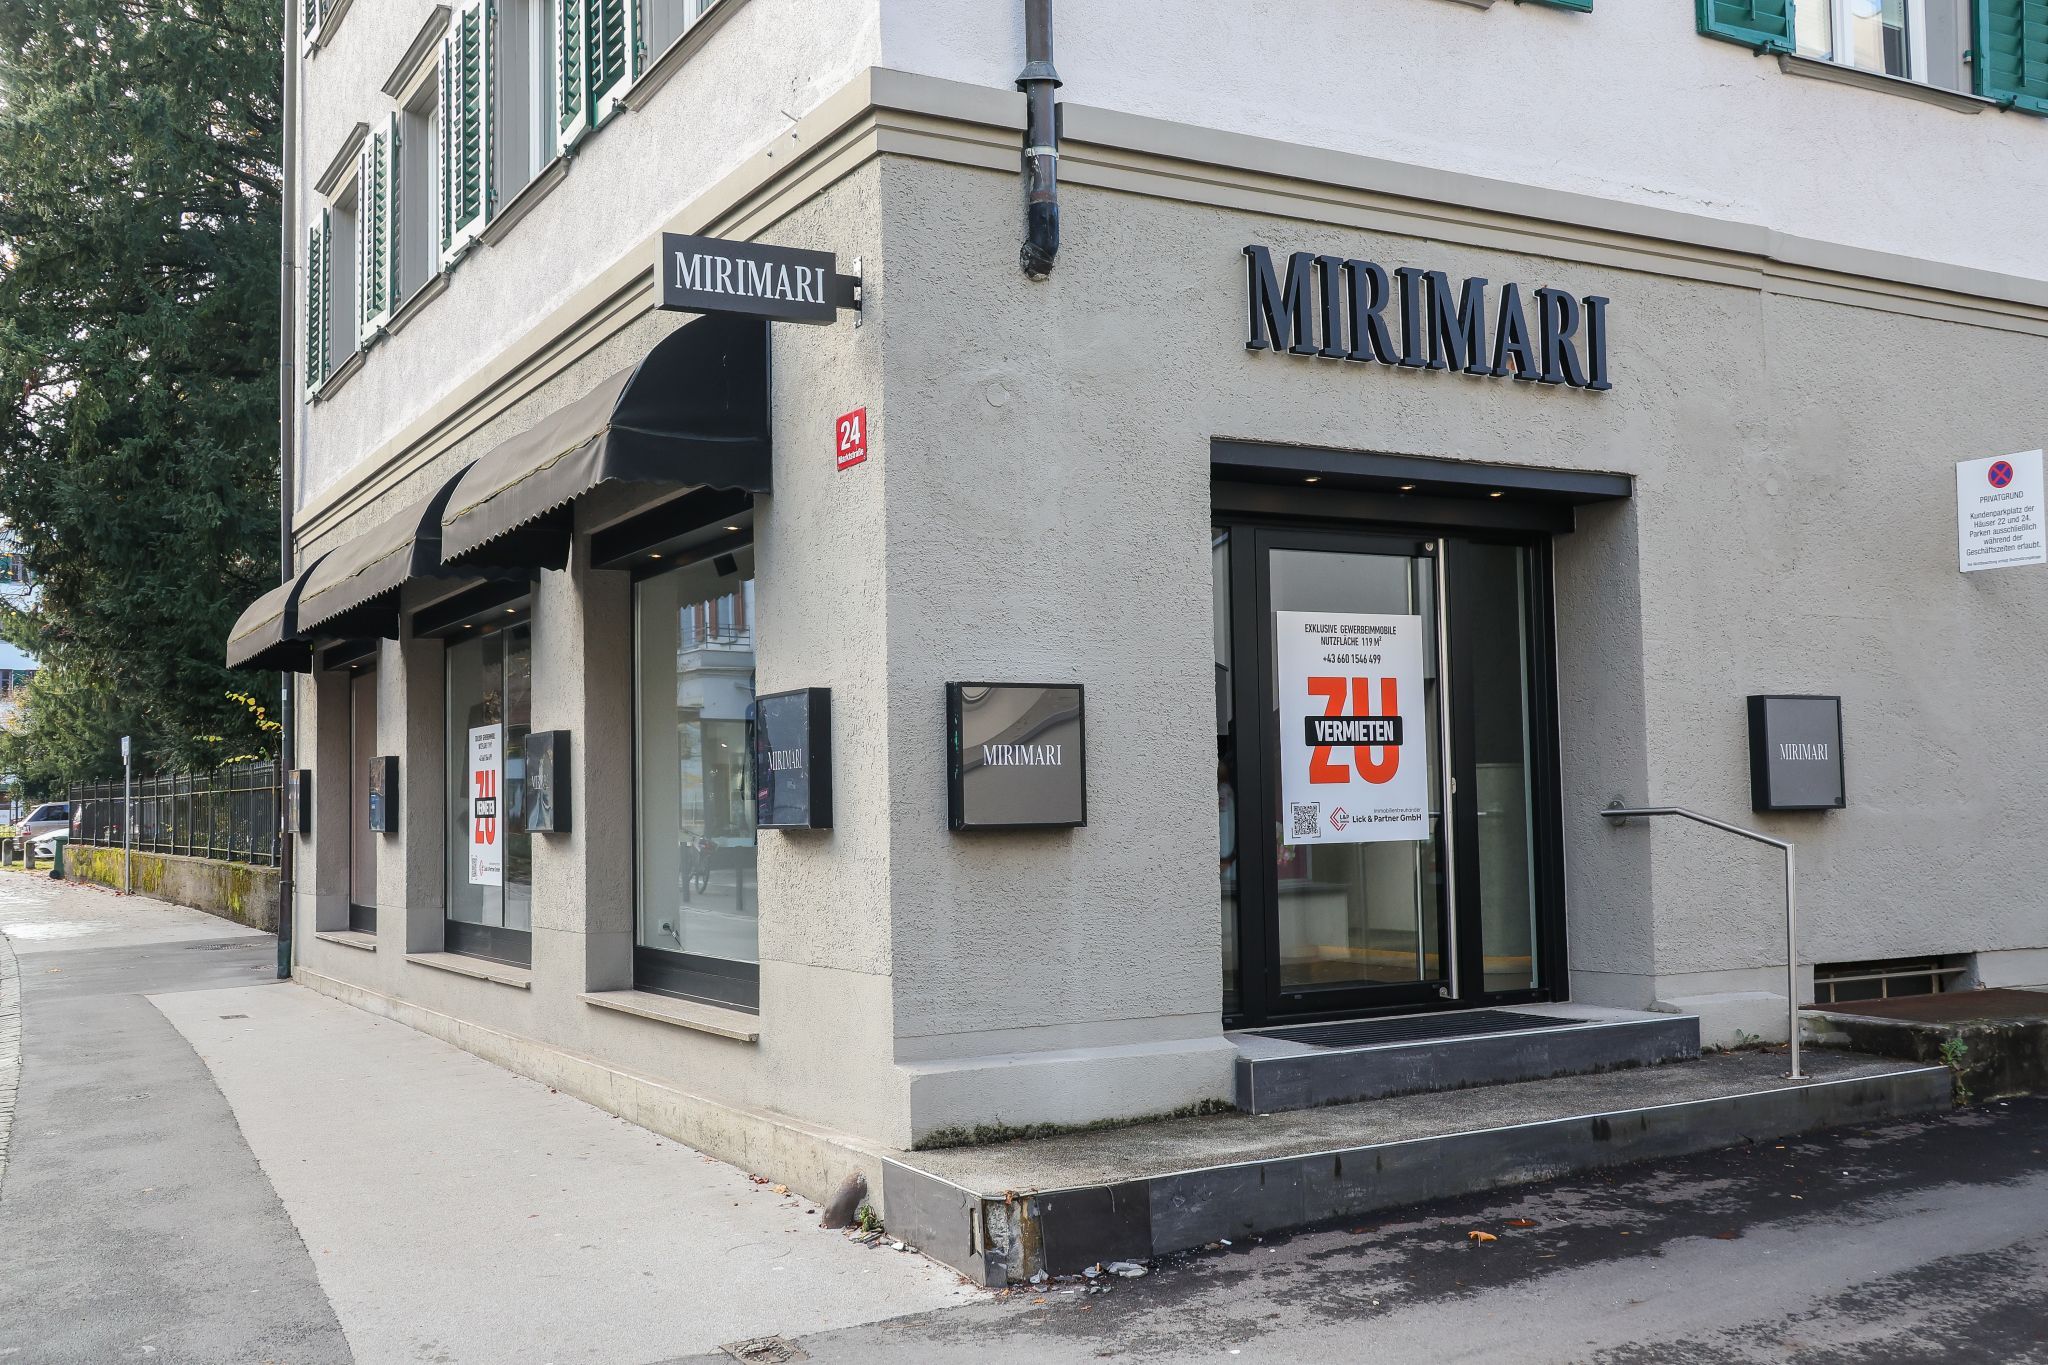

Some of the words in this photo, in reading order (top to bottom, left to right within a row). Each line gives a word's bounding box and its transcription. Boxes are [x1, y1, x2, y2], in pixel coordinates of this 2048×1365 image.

[675, 251, 826, 304] MIRIMARI
[1242, 244, 1613, 391] MIRIMARI
[841, 416, 861, 450] 24
[1980, 490, 2024, 503] PRIVATGRUND
[1970, 507, 2022, 519] Kundenparkplatz
[1973, 519, 1996, 528] Häuser
[2007, 516, 2019, 524] und
[2021, 514, 2031, 522] 24.
[1969, 529, 1990, 538] Parken
[1992, 523, 2037, 535] ausschließlich
[1983, 535, 2010, 545] während
[1966, 545, 2015, 556] Geschäftszeiten
[2017, 541, 2041, 550] erlaubt.
[1305, 624, 1337, 634] EXKLUSIVE
[1340, 625, 1397, 635] GEWERBEIMMOBILE
[1321, 635, 1359, 646] NUTZFLÄCHE
[1362, 637, 1373, 646] 119
[1323, 654, 1336, 664] +43
[1337, 654, 1350, 664] 660
[1351, 654, 1368, 664] 1546
[1369, 654, 1381, 664] 499
[1307, 677, 1400, 785] ZU
[1314, 720, 1394, 742] VERMIETEN
[983, 744, 1062, 766] MIRIMARI
[1780, 743, 1828, 760] MIRIMARI
[768, 748, 803, 771] MIRIMARI
[1352, 815, 1367, 823] Lick
[1374, 814, 1399, 822] Partner
[1400, 814, 1422, 822] GmbH
